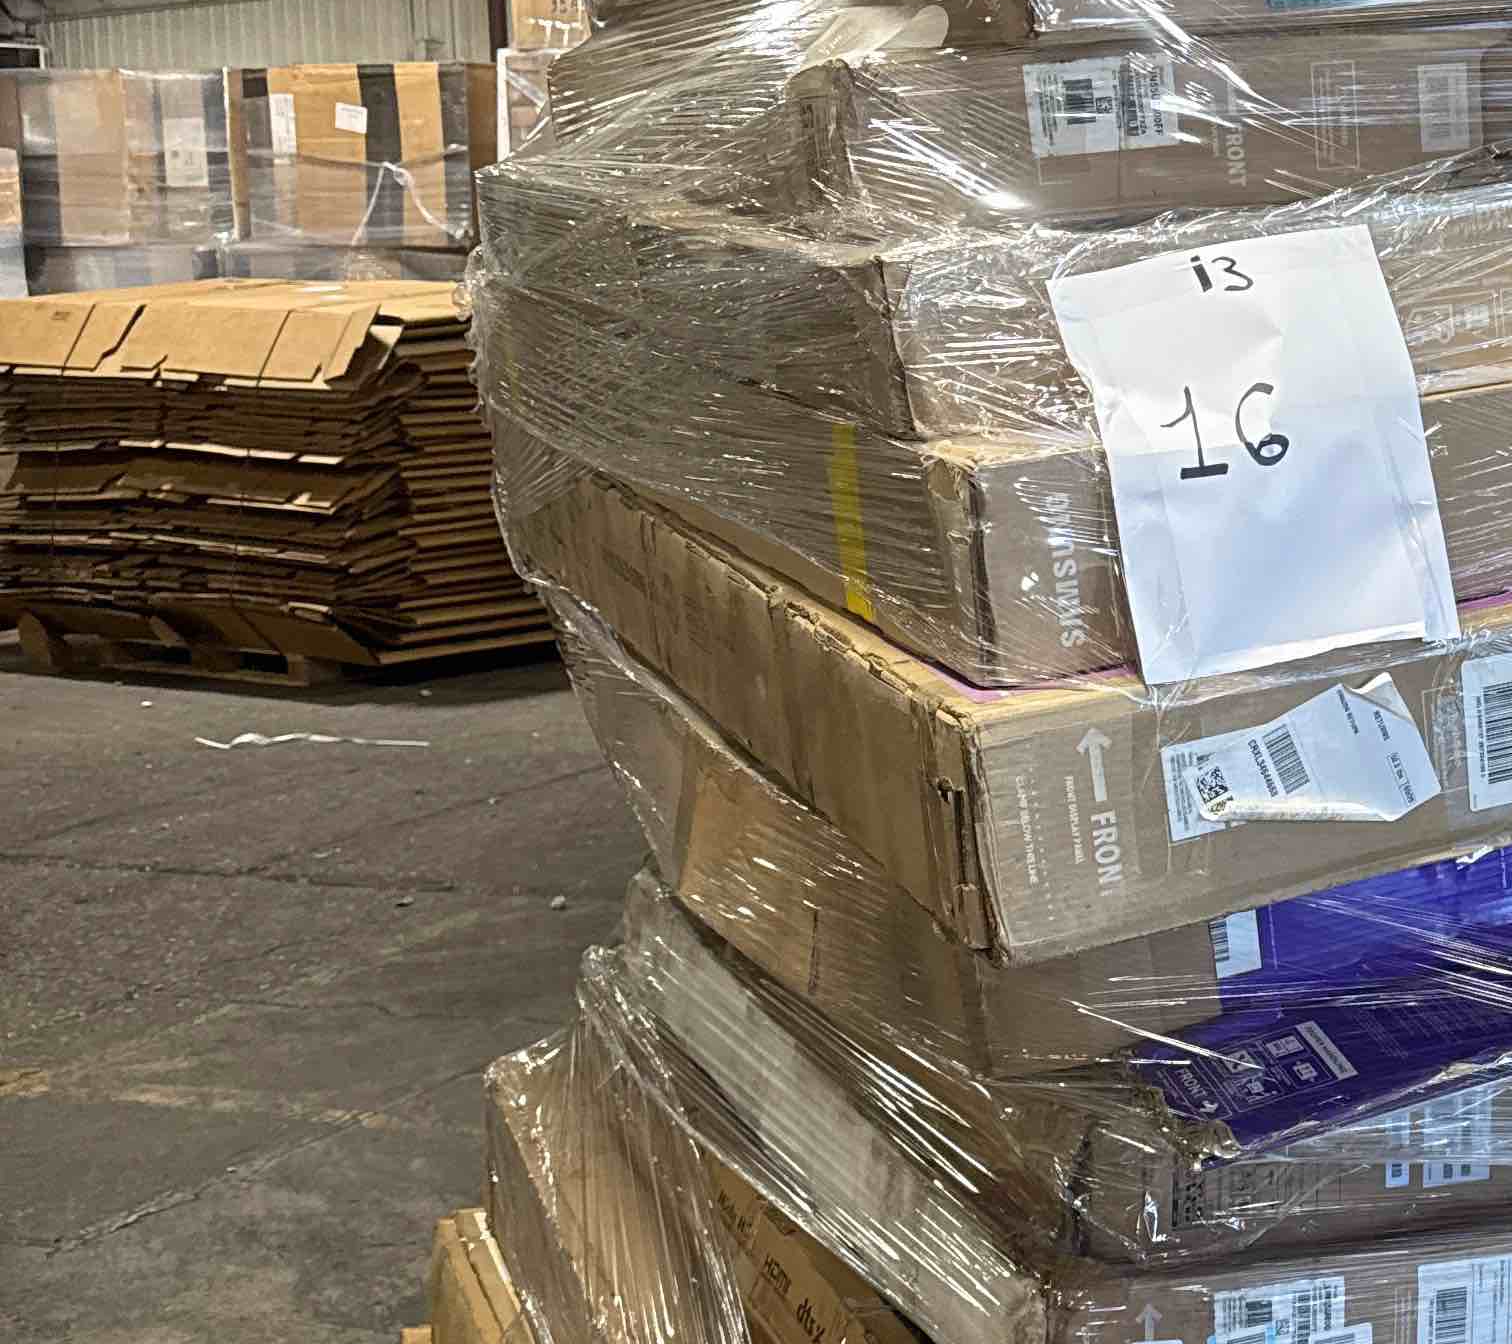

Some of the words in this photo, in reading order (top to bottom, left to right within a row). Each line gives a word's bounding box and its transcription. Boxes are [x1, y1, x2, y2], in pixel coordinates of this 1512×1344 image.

[1226, 124, 1247, 187] FRONT
[1191, 255, 1254, 296] i3
[1159, 382, 1290, 480] 16
